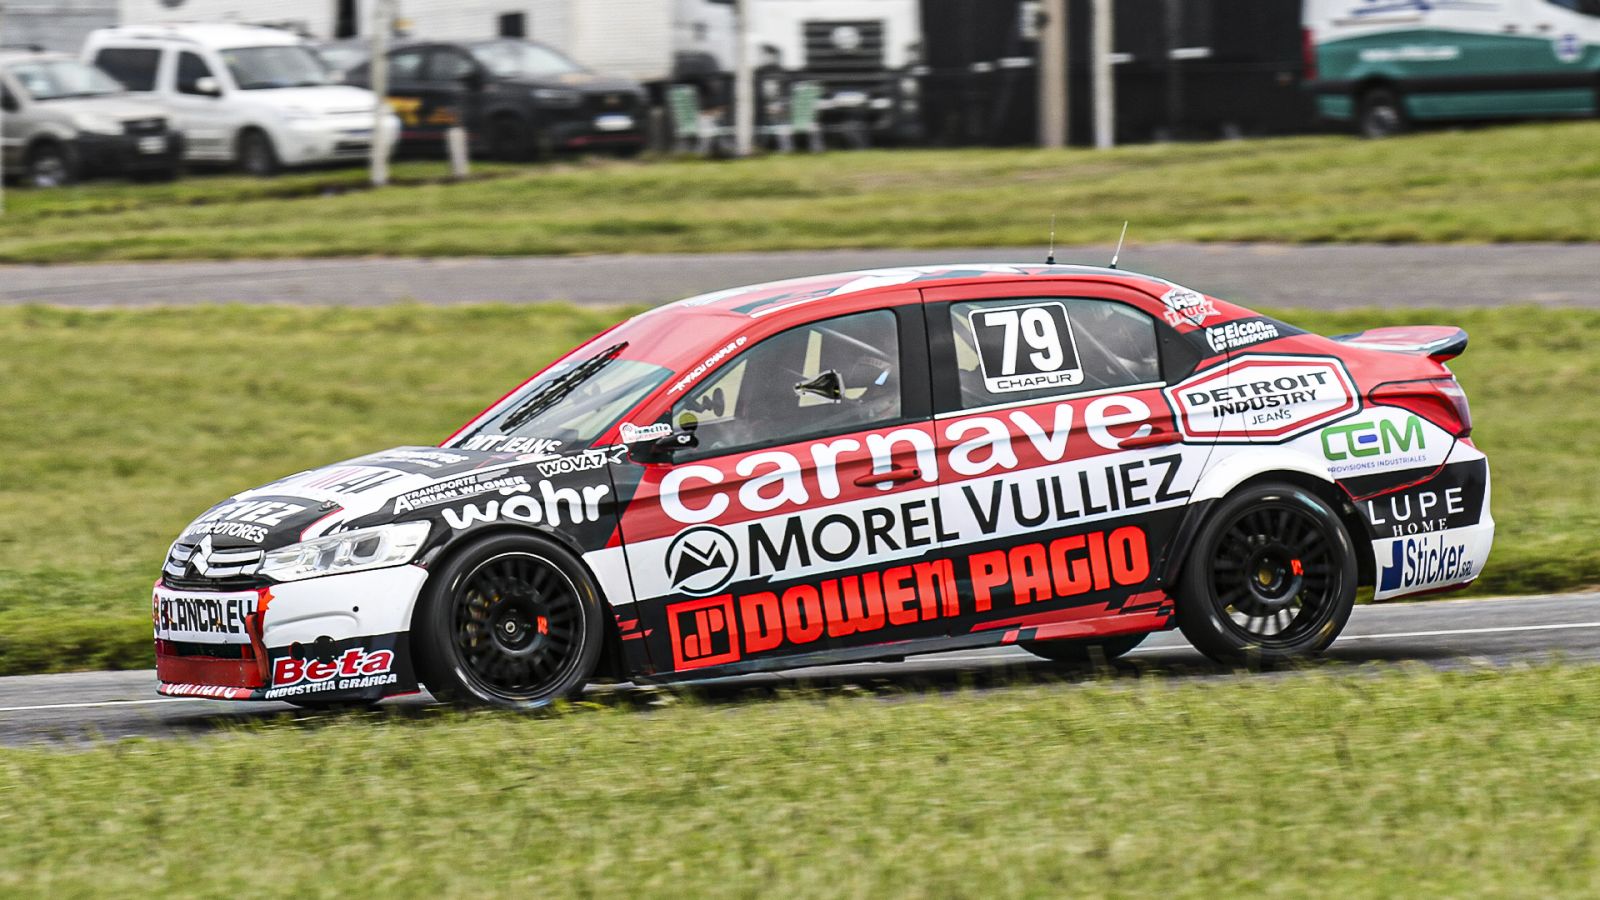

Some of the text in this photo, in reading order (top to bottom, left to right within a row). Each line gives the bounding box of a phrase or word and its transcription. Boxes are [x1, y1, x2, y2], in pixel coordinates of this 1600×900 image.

[984, 307, 1064, 376] 79
[997, 373, 1072, 389] CHAPUR
[1186, 371, 1327, 407] DETROIT
[1213, 389, 1317, 417] INDUSTRY
[1252, 409, 1292, 425] JEANS
[496, 436, 563, 455] JEANS
[1321, 415, 1426, 461] CEM
[659, 395, 1153, 524] carnave
[1327, 455, 1427, 473] PROVISIONES INDUSTRIALES
[393, 475, 526, 515] ADRIAN WAGNER
[405, 475, 477, 501] TRANSPORTE
[1367, 487, 1465, 526] LUPE
[747, 453, 1191, 577] MOREL VULLIEZ
[1392, 518, 1449, 537] HOME
[1404, 534, 1465, 588] Sticker
[738, 557, 960, 654] DOWEN
[968, 525, 1150, 613] PAGIO
[161, 597, 254, 634] BLANCALEY
[272, 647, 394, 689] Beta
[265, 680, 336, 699] INDUSTRIA
